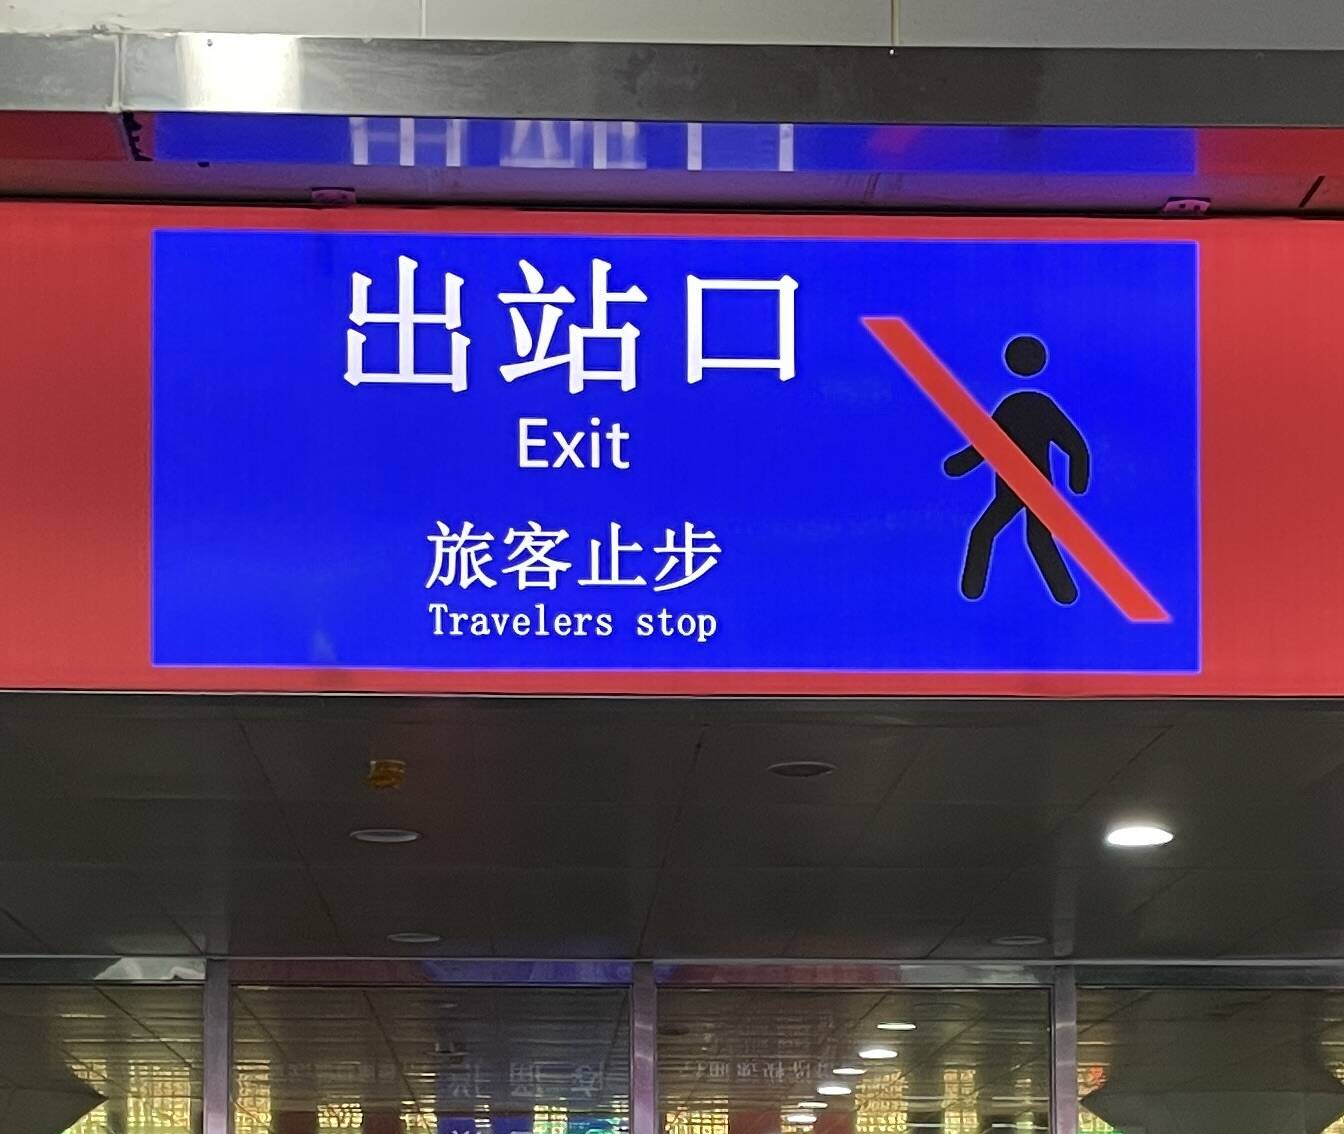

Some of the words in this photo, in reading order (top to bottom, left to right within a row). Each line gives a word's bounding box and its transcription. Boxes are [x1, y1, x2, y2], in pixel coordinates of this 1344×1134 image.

[343, 255, 800, 396] 出站口
[517, 416, 631, 470] Exit
[424, 519, 723, 593] 旅客止步
[427, 603, 614, 637] Travelers
[636, 607, 718, 644] stop
